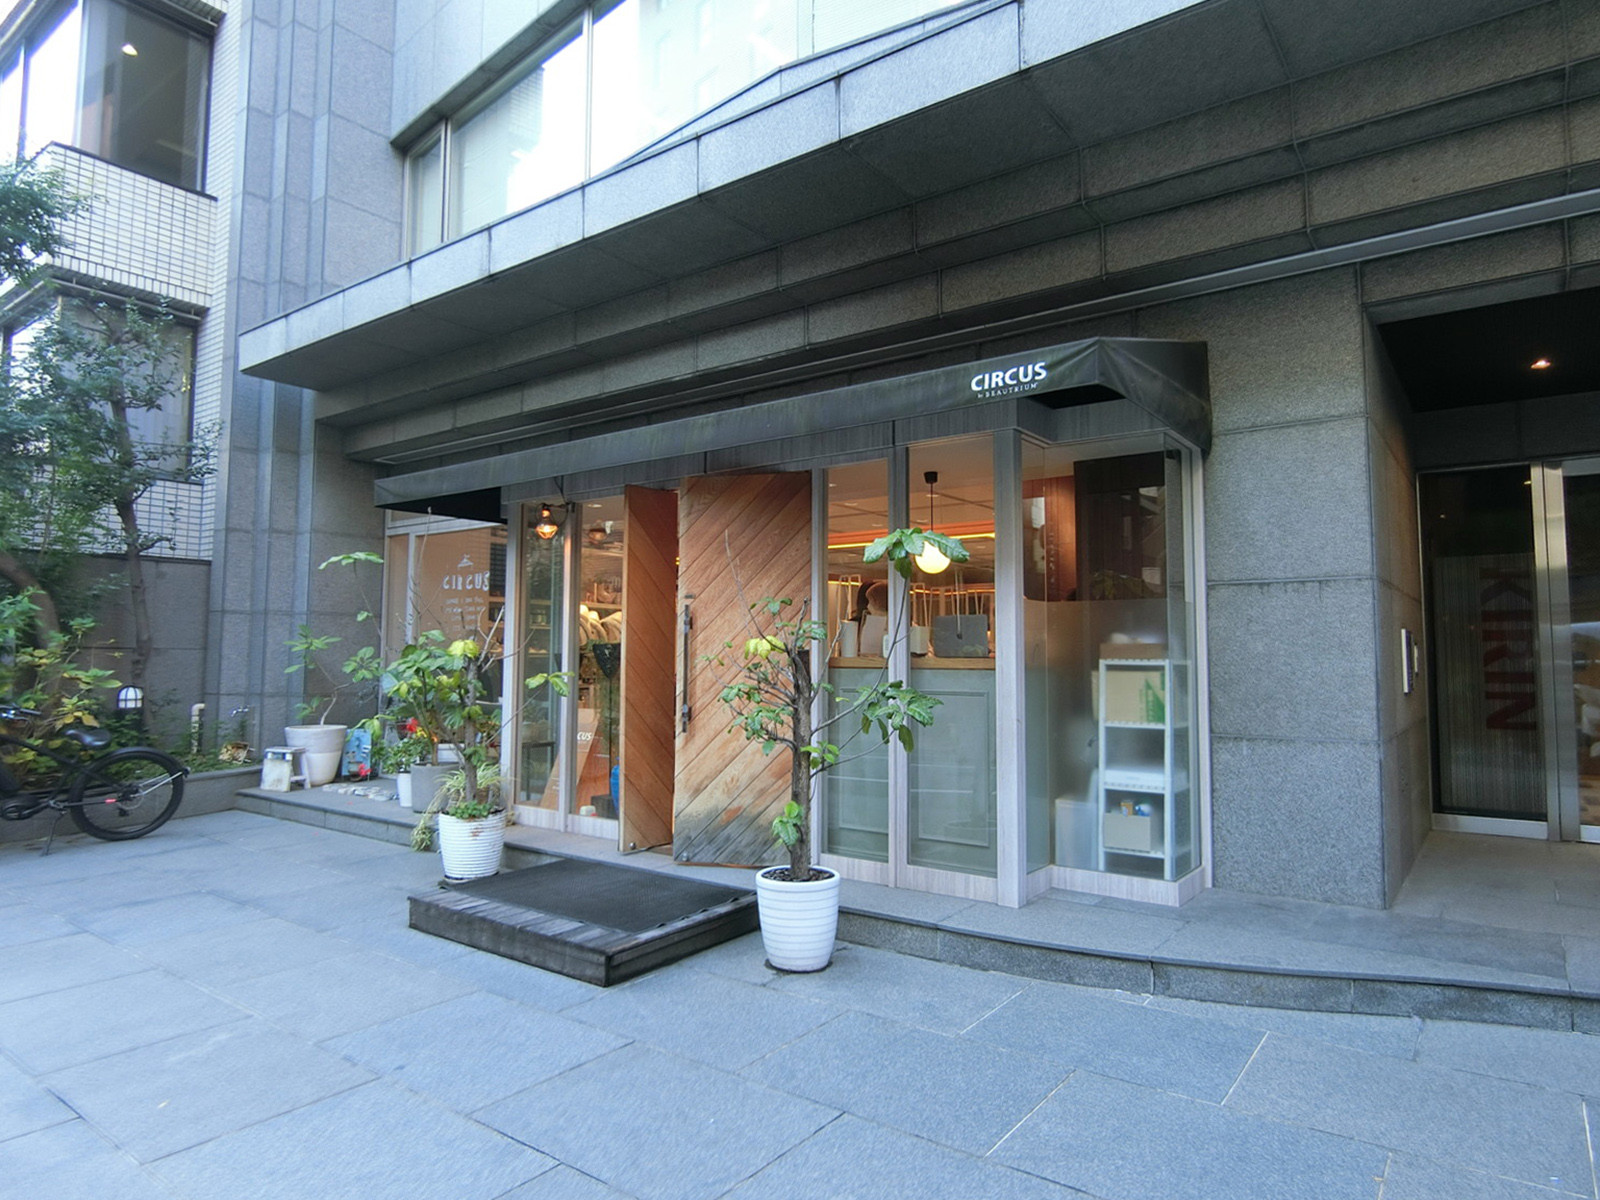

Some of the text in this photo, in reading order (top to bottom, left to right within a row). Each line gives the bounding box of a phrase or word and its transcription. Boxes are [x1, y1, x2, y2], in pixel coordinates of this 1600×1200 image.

[971, 362, 1048, 391] CIRCUS
[985, 382, 1038, 398] BEAUTRIUM
[443, 570, 490, 591] CIRCUS
[1480, 567, 1537, 731] KIRIN
[577, 731, 593, 741] CUS
